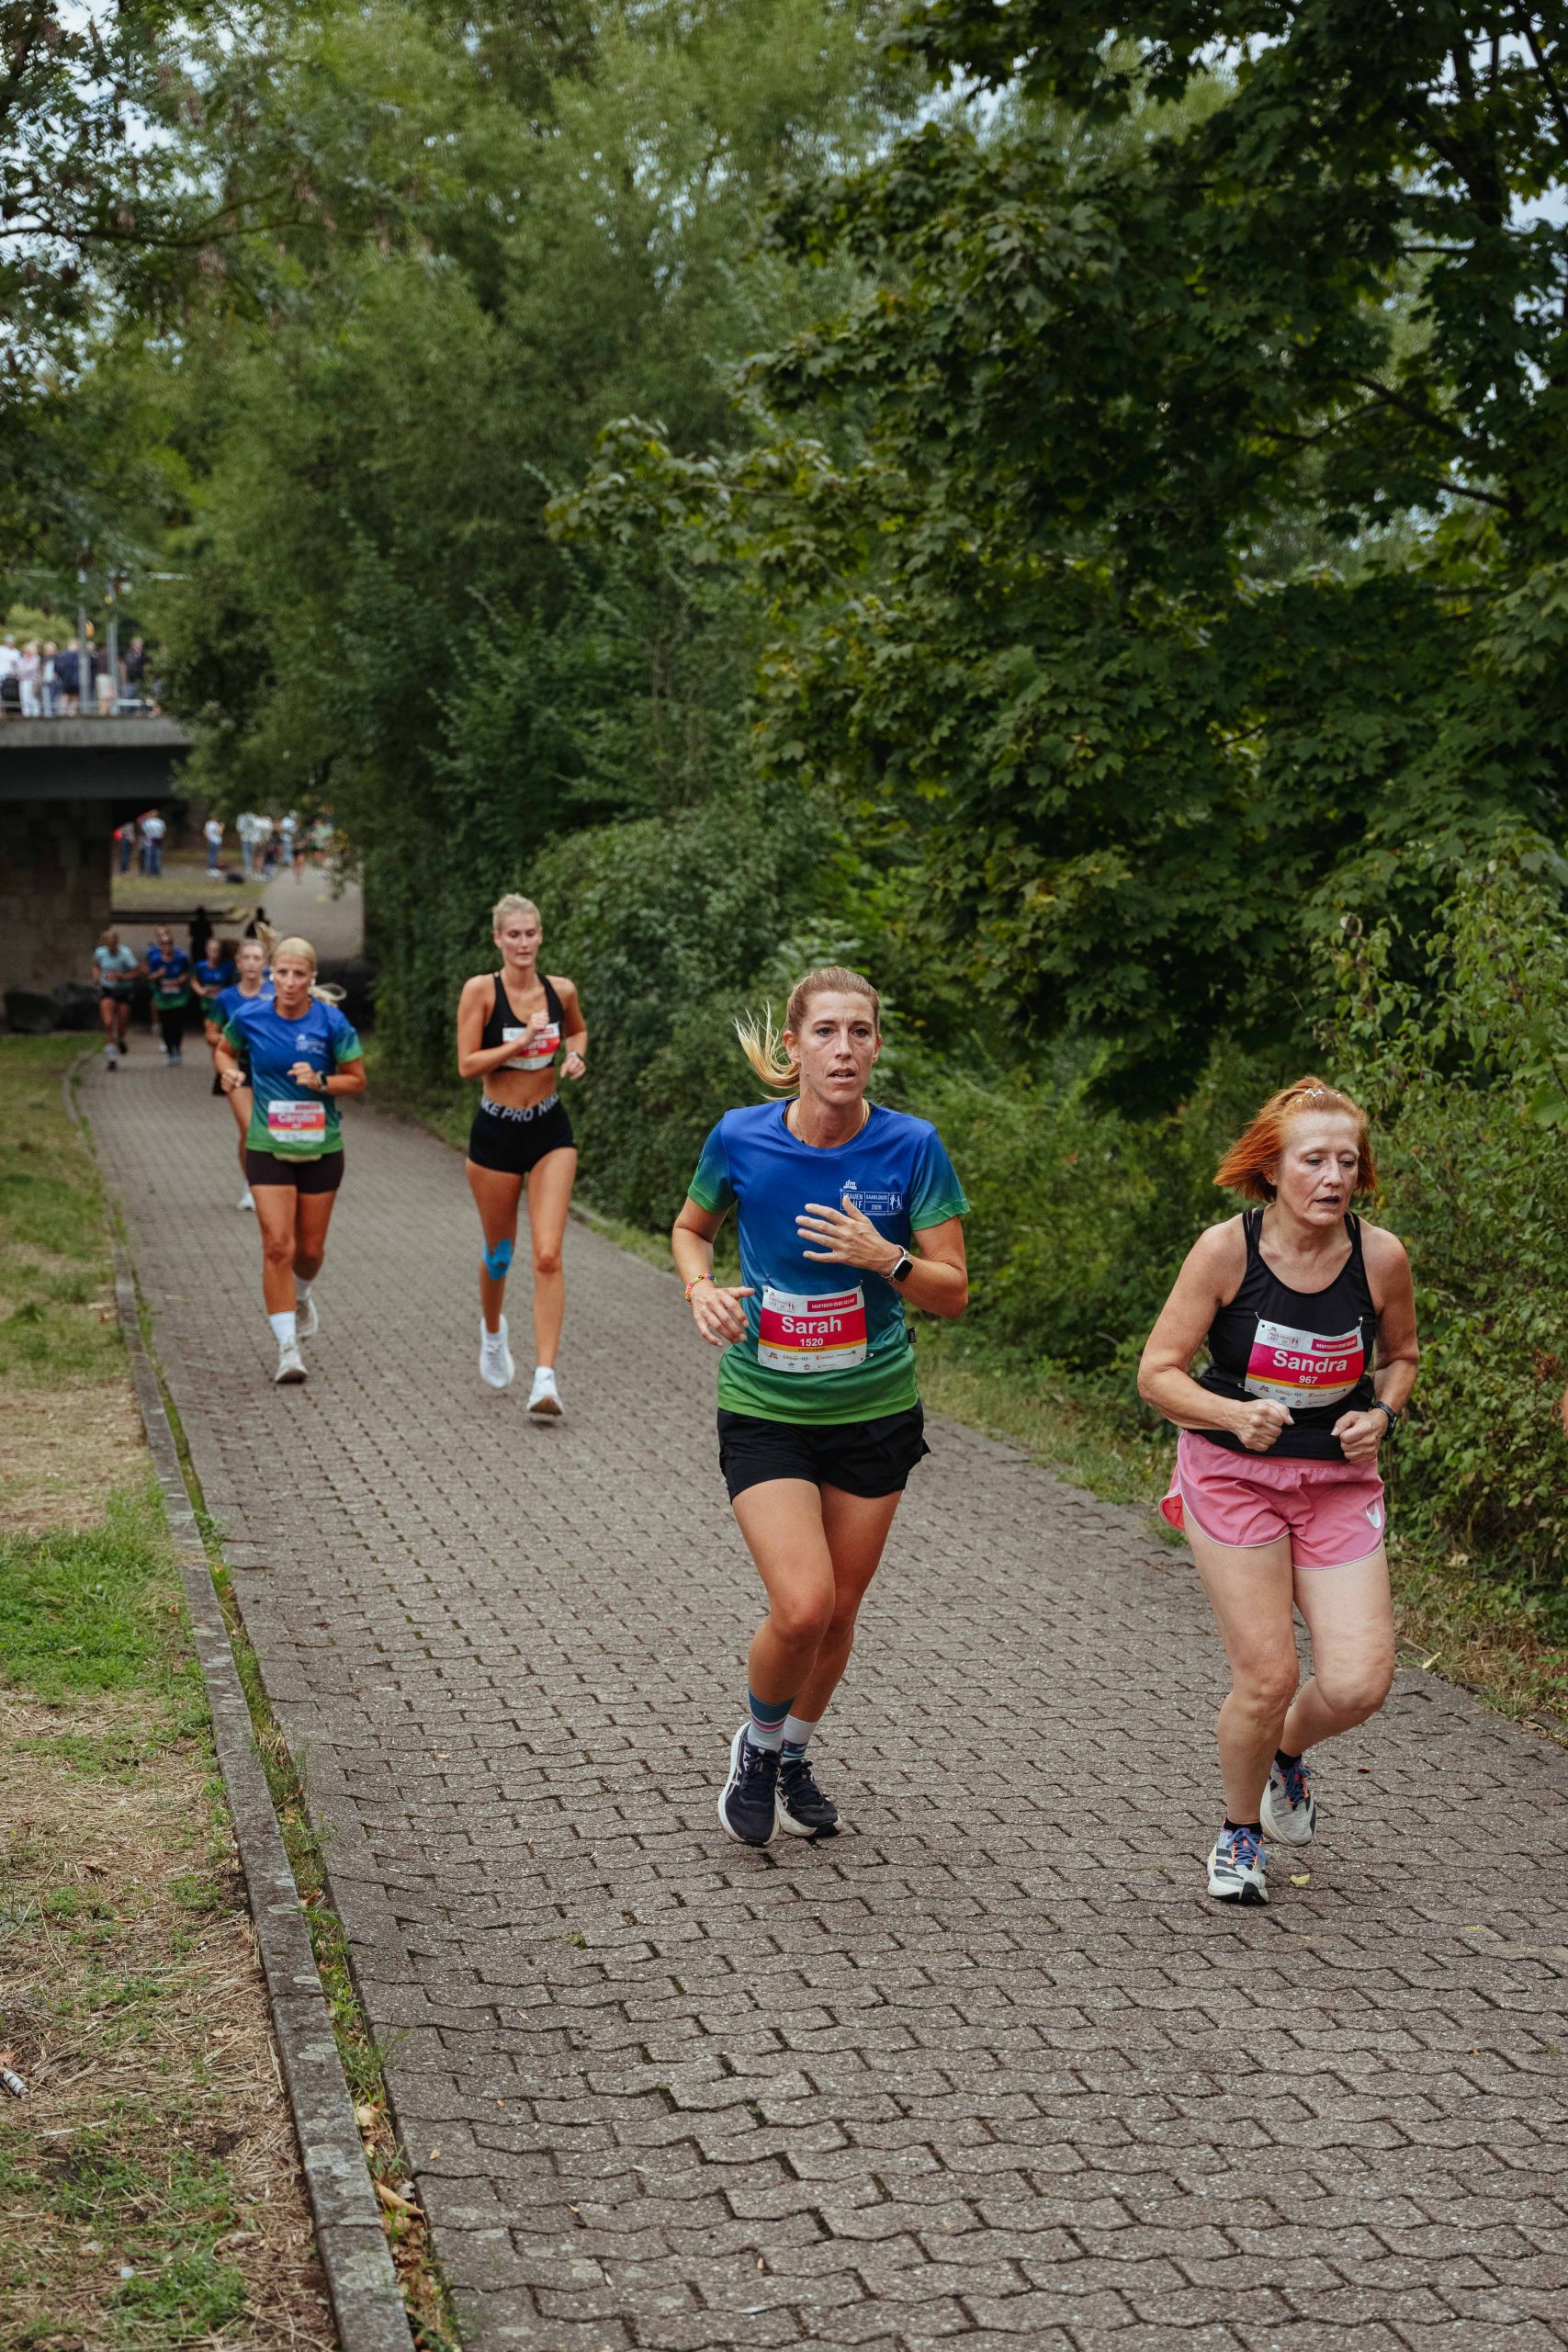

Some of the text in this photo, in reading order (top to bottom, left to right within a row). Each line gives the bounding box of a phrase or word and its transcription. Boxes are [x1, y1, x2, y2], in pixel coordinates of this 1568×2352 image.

[501, 1106, 534, 1122] PRO
[781, 1316, 842, 1334] Sarah
[799, 1338, 824, 1347] 1520
[1272, 1350, 1348, 1374] Sandra
[1299, 1375, 1318, 1385] 967
